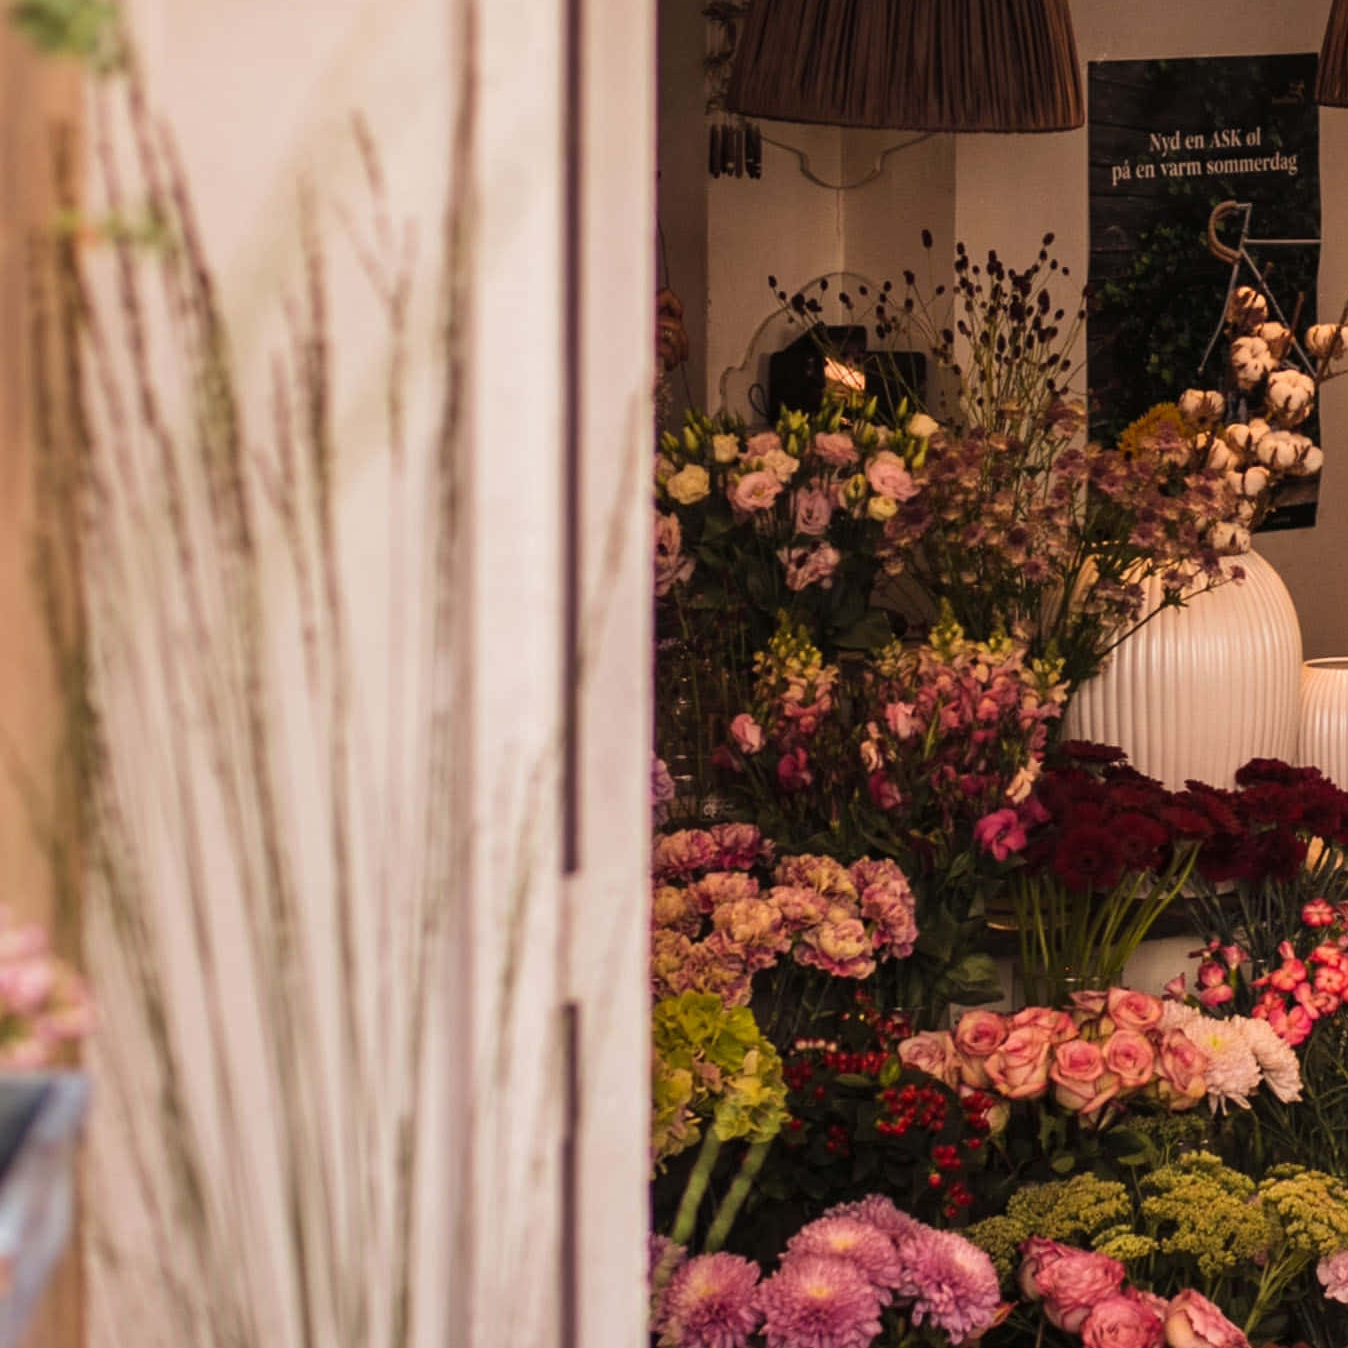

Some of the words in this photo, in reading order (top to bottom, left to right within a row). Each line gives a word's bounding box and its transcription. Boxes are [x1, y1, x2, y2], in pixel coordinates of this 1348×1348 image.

[1150, 131, 1181, 157] Nyd
[1185, 134, 1205, 149] en
[1209, 128, 1242, 149] ASK
[1246, 126, 1262, 147] øl
[1111, 159, 1131, 187] på
[1136, 162, 1155, 179] en
[1160, 160, 1201, 178] varm
[1206, 151, 1299, 175] sommerdag
